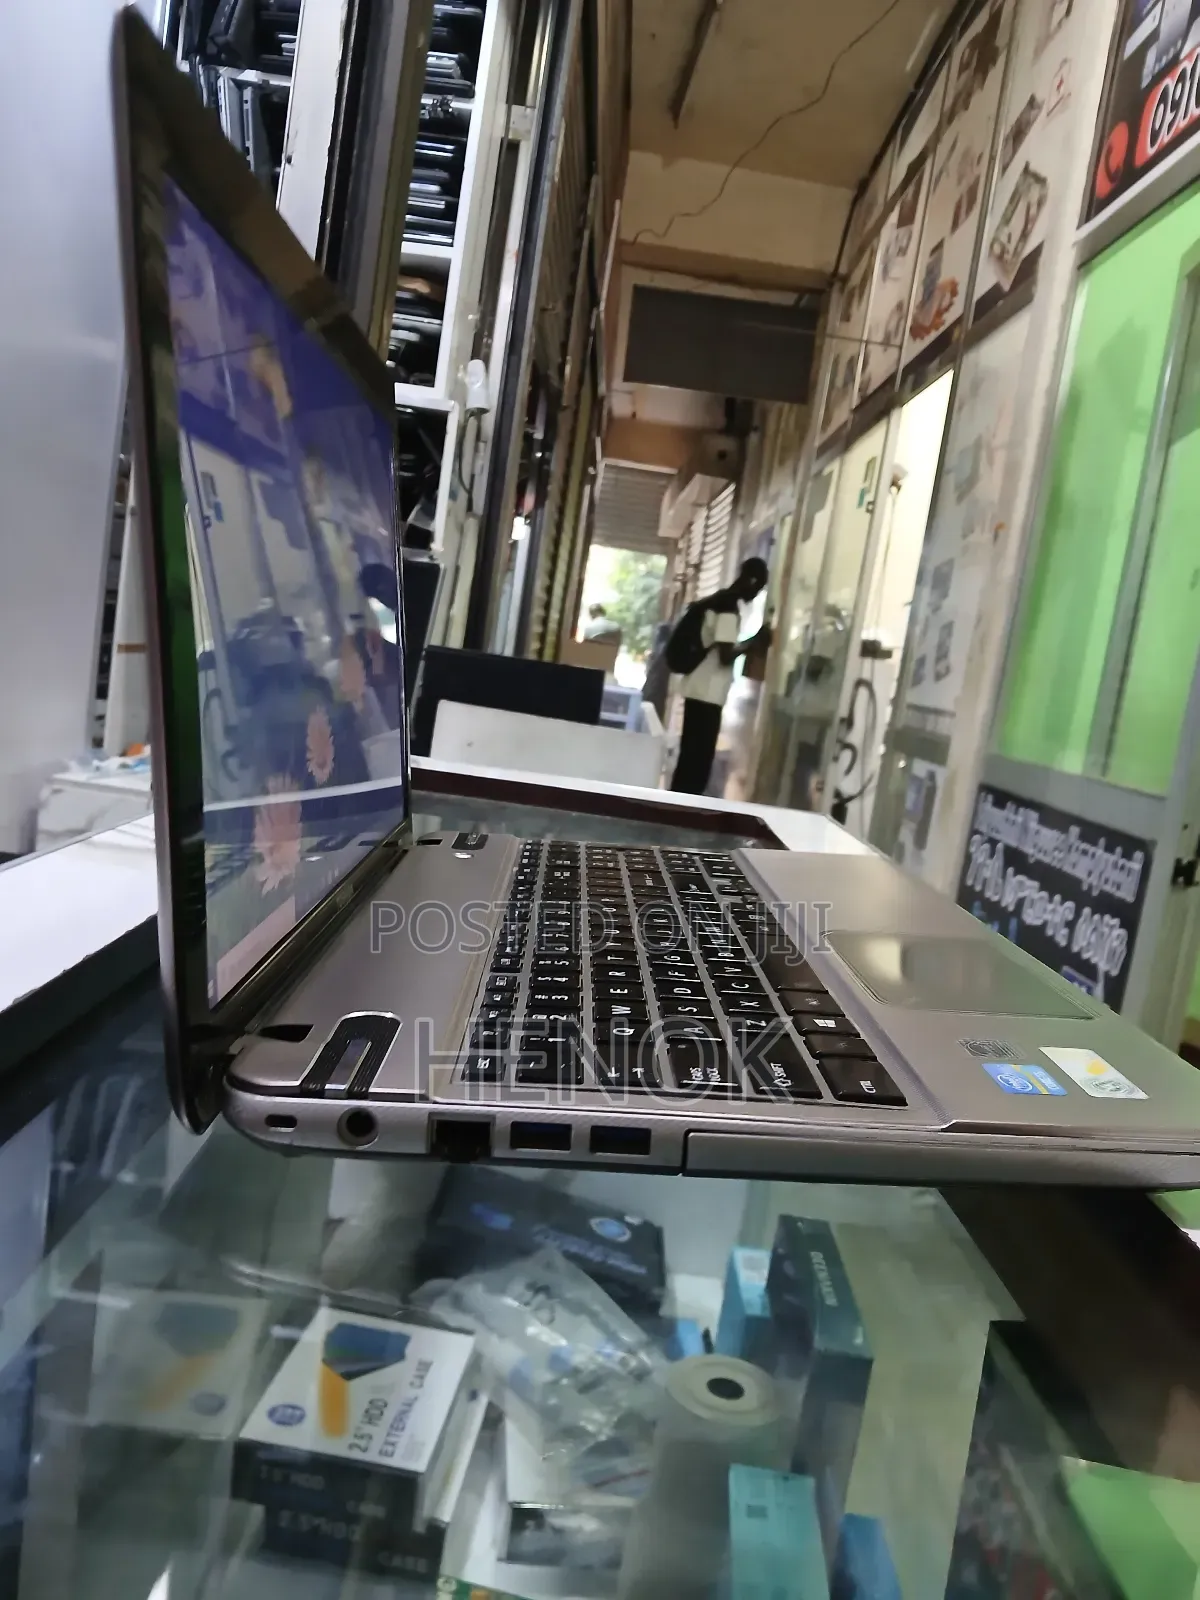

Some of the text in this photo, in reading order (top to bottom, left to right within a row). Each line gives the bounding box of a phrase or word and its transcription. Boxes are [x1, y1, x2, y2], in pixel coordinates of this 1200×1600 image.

[731, 981, 750, 989] C
[611, 1005, 632, 1015] W
[677, 1005, 698, 1013] S
[745, 1019, 767, 1027] Z
[612, 1027, 636, 1036] Q
[683, 1026, 705, 1034] A
